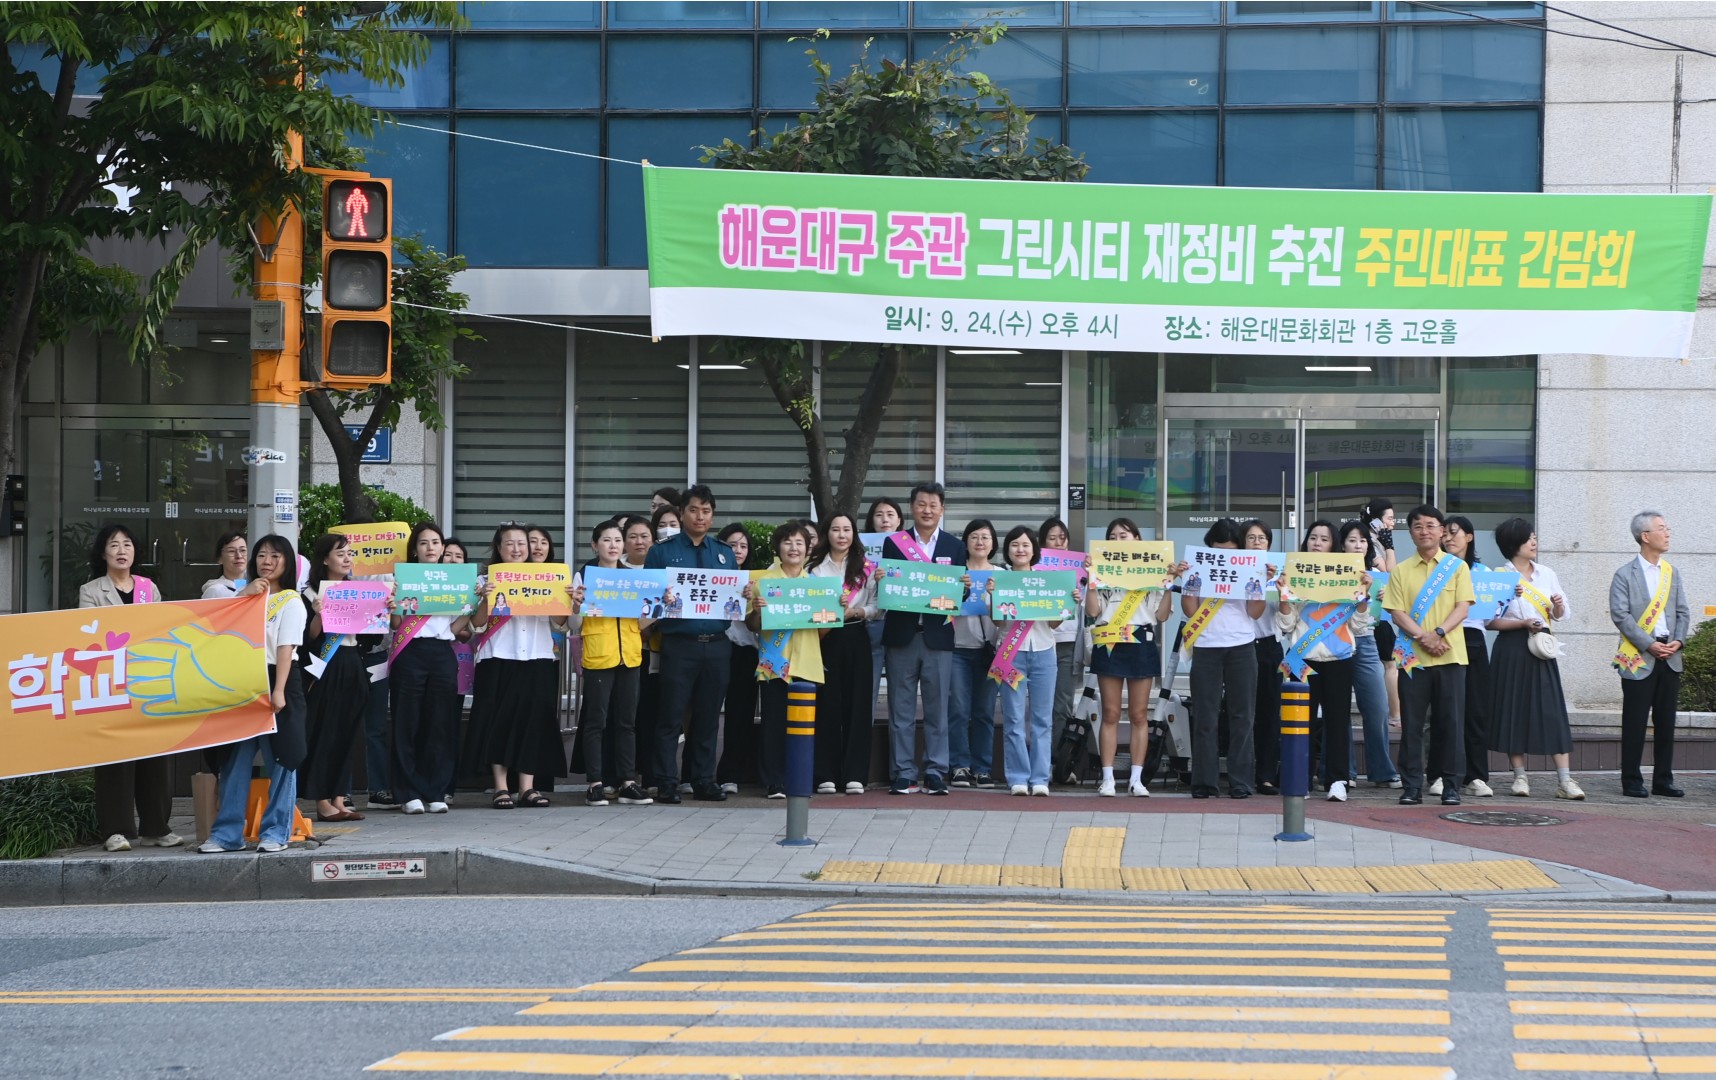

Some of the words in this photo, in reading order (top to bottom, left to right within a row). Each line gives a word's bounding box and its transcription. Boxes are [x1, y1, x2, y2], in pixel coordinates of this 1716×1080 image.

[718, 203, 877, 277] 해운대구
[885, 211, 969, 280] 주관
[977, 218, 1130, 282] 그린시티
[1141, 222, 1256, 286] 재정비
[1268, 224, 1345, 287] 추진
[1354, 228, 1508, 288] 주민대표
[1518, 230, 1636, 290] 간담회
[885, 306, 932, 331] 일시:
[941, 310, 959, 334] 9.
[967, 310, 1032, 336] 24.(수)
[1040, 314, 1080, 337] 오후
[1088, 315, 1119, 339] 4시
[1165, 315, 1211, 342] 장소:
[1220, 317, 1356, 344] 해운대문화회관
[1365, 318, 1393, 344] 1층
[1401, 319, 1459, 345] 고운홀
[344, 533, 372, 545] 력보다
[375, 532, 406, 541] 대화가
[362, 547, 394, 558] 멋지다
[1102, 551, 1129, 562] 학교는
[1131, 552, 1164, 563] 배움터,
[1195, 551, 1226, 567] 폭력은
[1230, 556, 1257, 567] OUT!
[1097, 564, 1123, 576] 폭력은
[1126, 567, 1169, 576] 사라져라
[1295, 563, 1322, 575] 학교는
[1324, 564, 1356, 575] 배움터,
[424, 570, 448, 581] 친구는
[495, 572, 532, 583] 폭력보다
[534, 572, 565, 582] 대화가
[676, 572, 708, 587] 폭력은
[711, 575, 738, 587] OUT!
[1209, 568, 1239, 583] 존중은
[402, 582, 429, 593] 때리는
[430, 583, 440, 591] 게
[442, 583, 469, 592] 아니라
[616, 580, 632, 590] 웃는
[633, 580, 660, 590] 학교가
[1022, 577, 1047, 587] 친구는
[1290, 576, 1316, 589] 폭력은
[1318, 579, 1359, 588] 사라져라
[326, 589, 358, 600] 학교폭력
[361, 591, 385, 600] STOP!
[508, 588, 518, 596] 더
[521, 587, 552, 598] 멋지다
[885, 584, 909, 597] 폭력은
[911, 587, 931, 598] 없다
[998, 588, 1025, 599] 때리는
[1038, 588, 1067, 597] 아니라
[1215, 584, 1231, 595] IN!
[423, 594, 456, 605] 지켜주는
[458, 594, 468, 604] 것
[621, 591, 639, 601] 학교
[689, 589, 719, 602] 존중은
[695, 604, 711, 615] IN!
[767, 603, 791, 614] 폭력은
[793, 603, 812, 614] 없다
[1020, 600, 1053, 609] 지켜주는
[1055, 599, 1065, 609] 것
[7, 646, 132, 721] 학교
[377, 861, 407, 870] 금연구역
